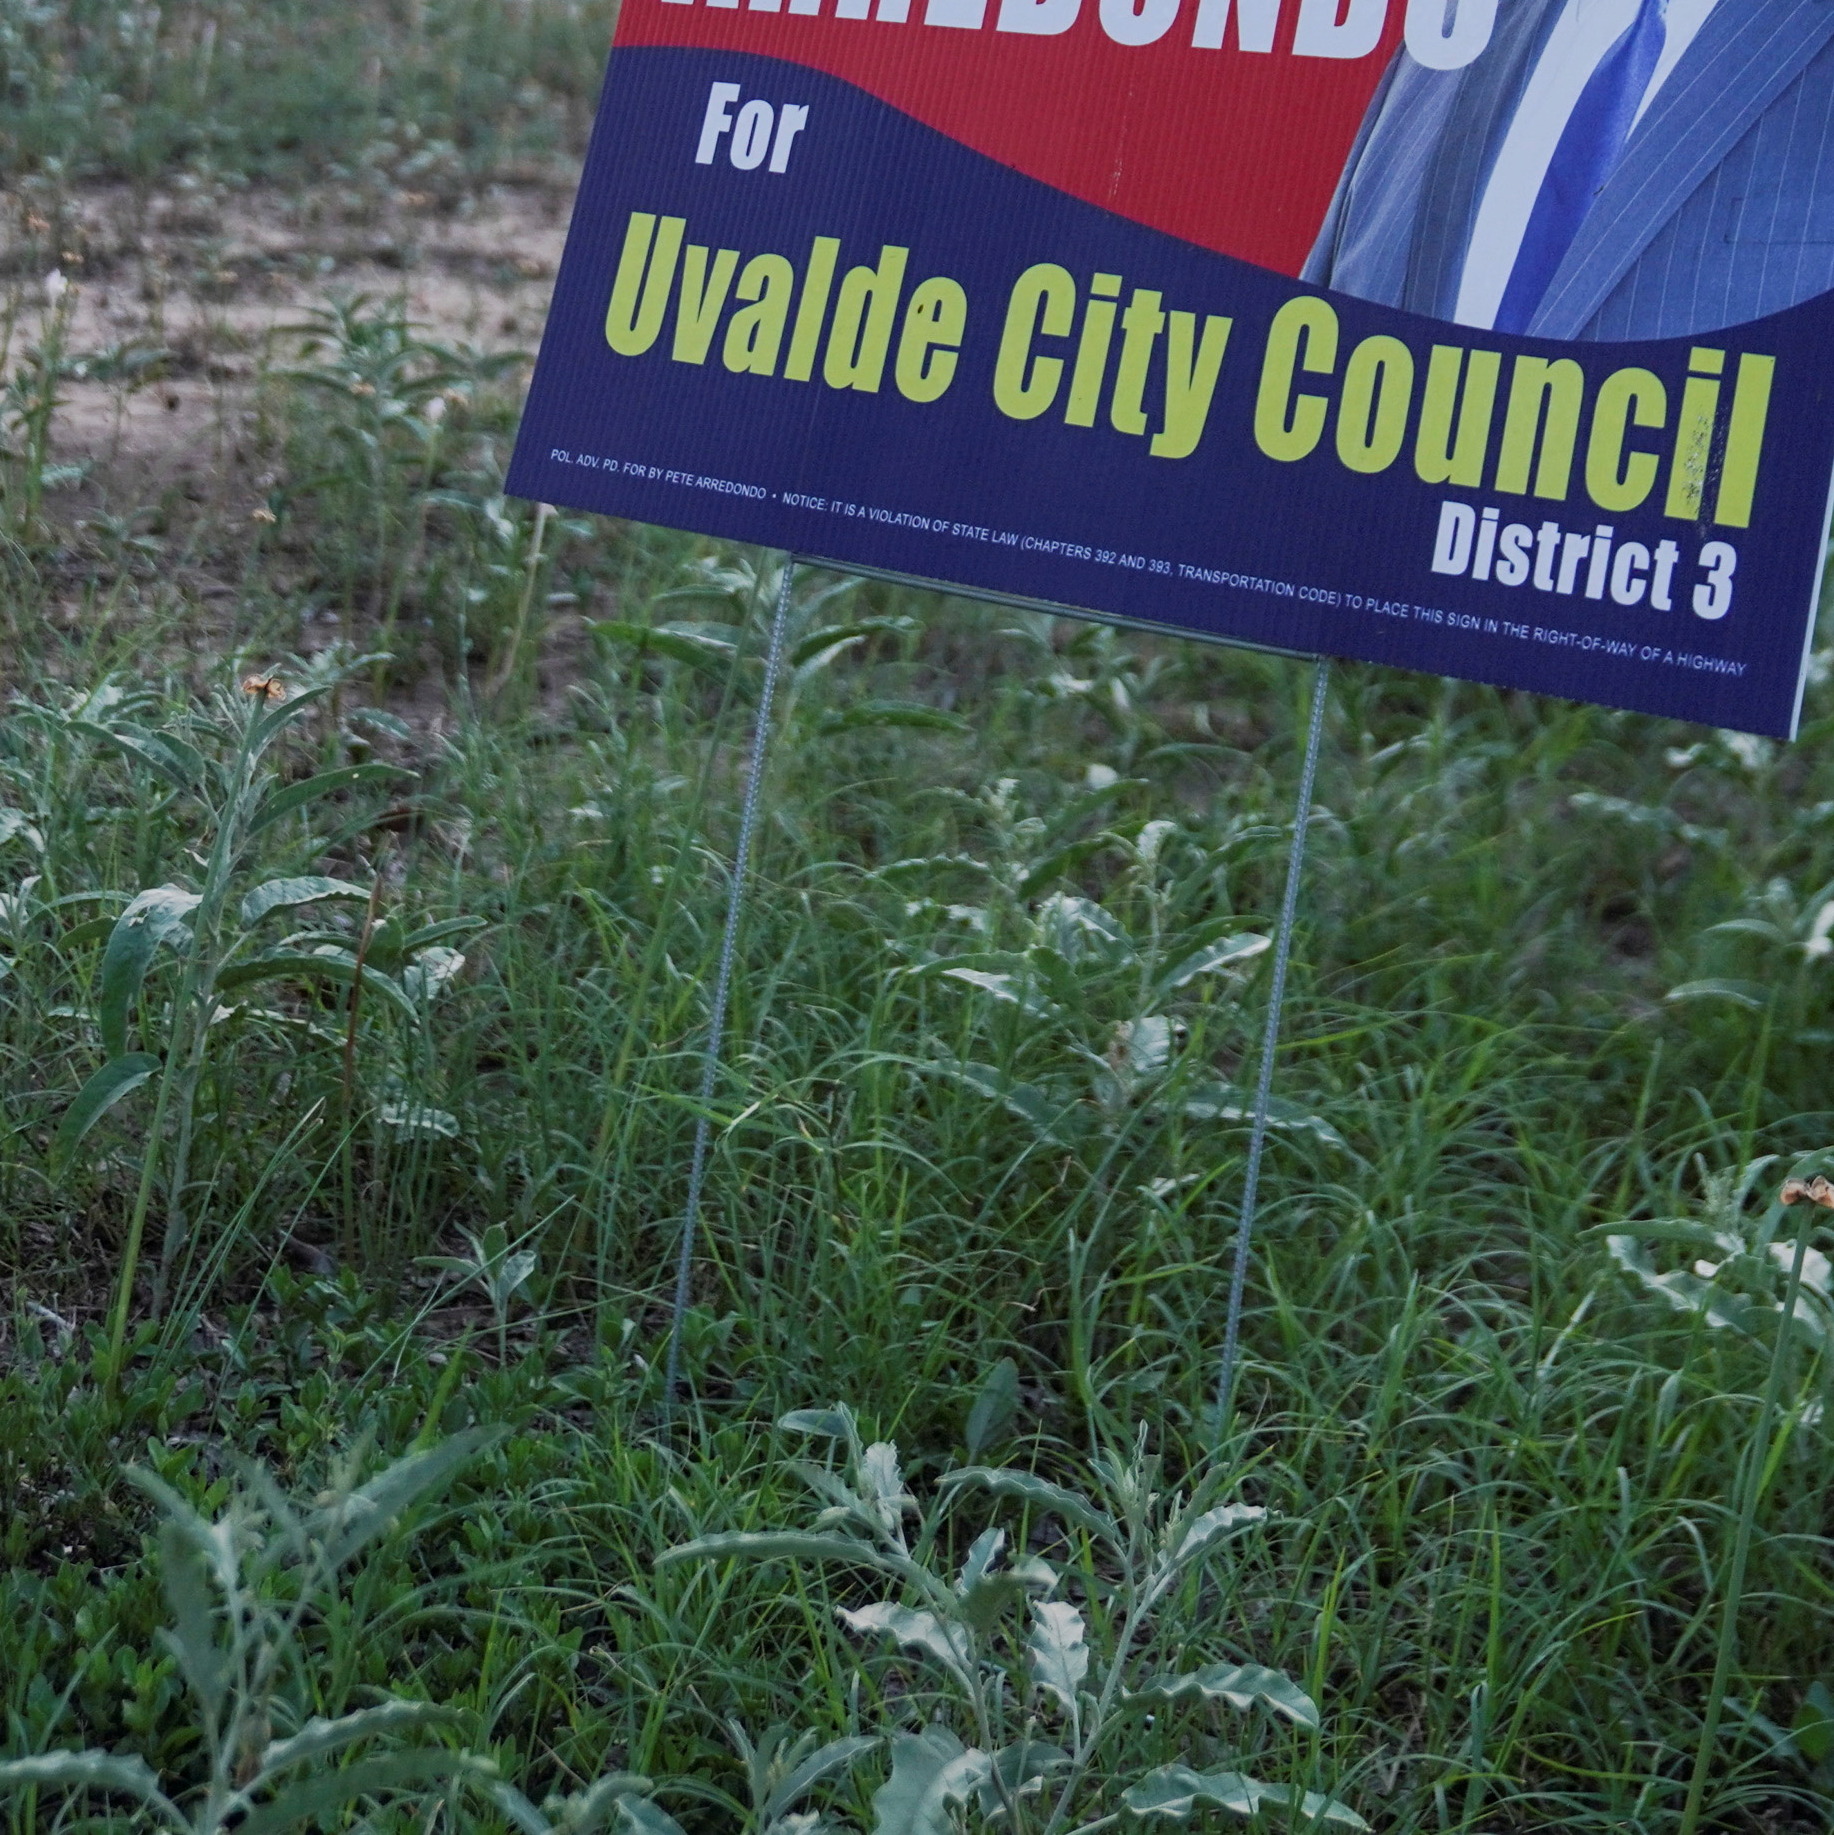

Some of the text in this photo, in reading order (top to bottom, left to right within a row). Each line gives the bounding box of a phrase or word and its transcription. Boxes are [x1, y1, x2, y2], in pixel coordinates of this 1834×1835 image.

[695, 82, 809, 173] For
[607, 214, 1775, 528] Uvalde City Council
[551, 448, 1748, 675] POL. ADV. PD. FOR BY PETE ARREDONDO NOTICE: IT IS A VIOLATION OF STATE LAW (CHAPTERS 392 AND 393, TRANSPORTATION CODE) TO PLACE THIS SIGN IN THE RIGHT-OF-WAY OF A HIGHWAY
[1431, 502, 1736, 619] District 3
